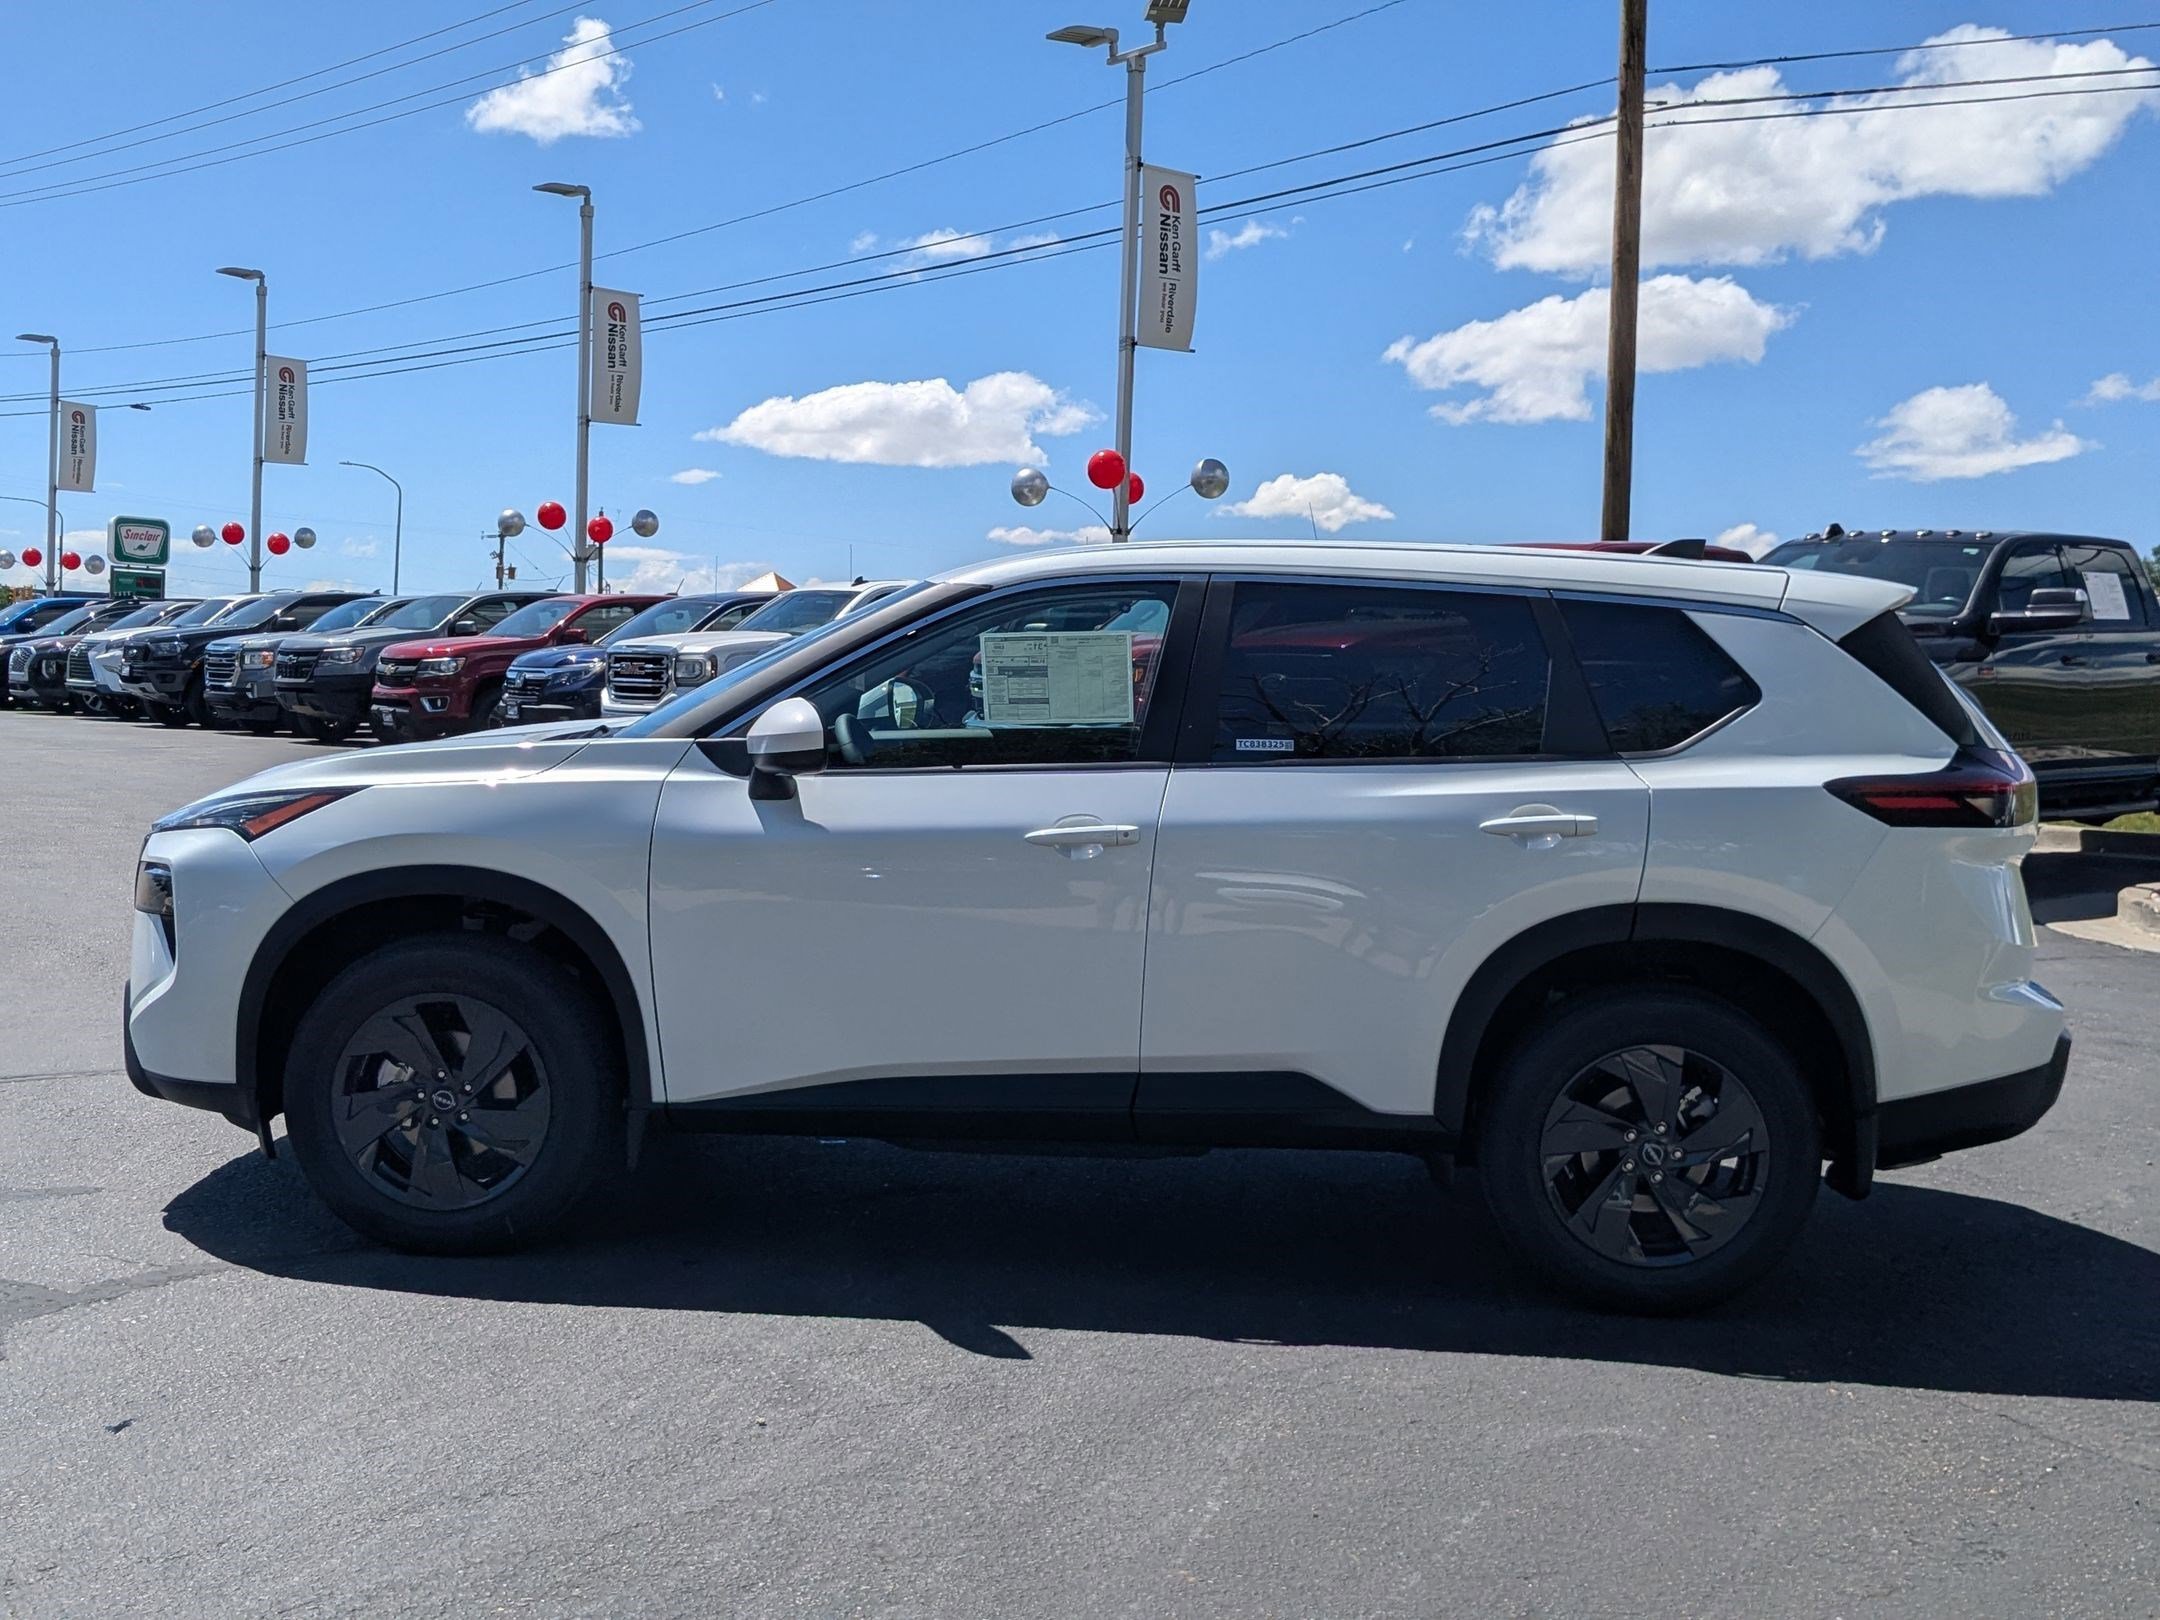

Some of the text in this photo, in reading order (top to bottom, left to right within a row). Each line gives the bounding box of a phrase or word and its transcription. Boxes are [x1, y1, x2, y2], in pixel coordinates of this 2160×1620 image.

[1159, 213, 1171, 275] Nissan
[1171, 215, 1181, 273] Ken Garff
[1165, 282, 1177, 334] Riverdale
[608, 323, 618, 369] Nissan
[619, 324, 628, 367] Ken Garff
[279, 384, 288, 420] Nissan
[71, 424, 79, 455] Nissan
[124, 528, 161, 542] Sinclair
